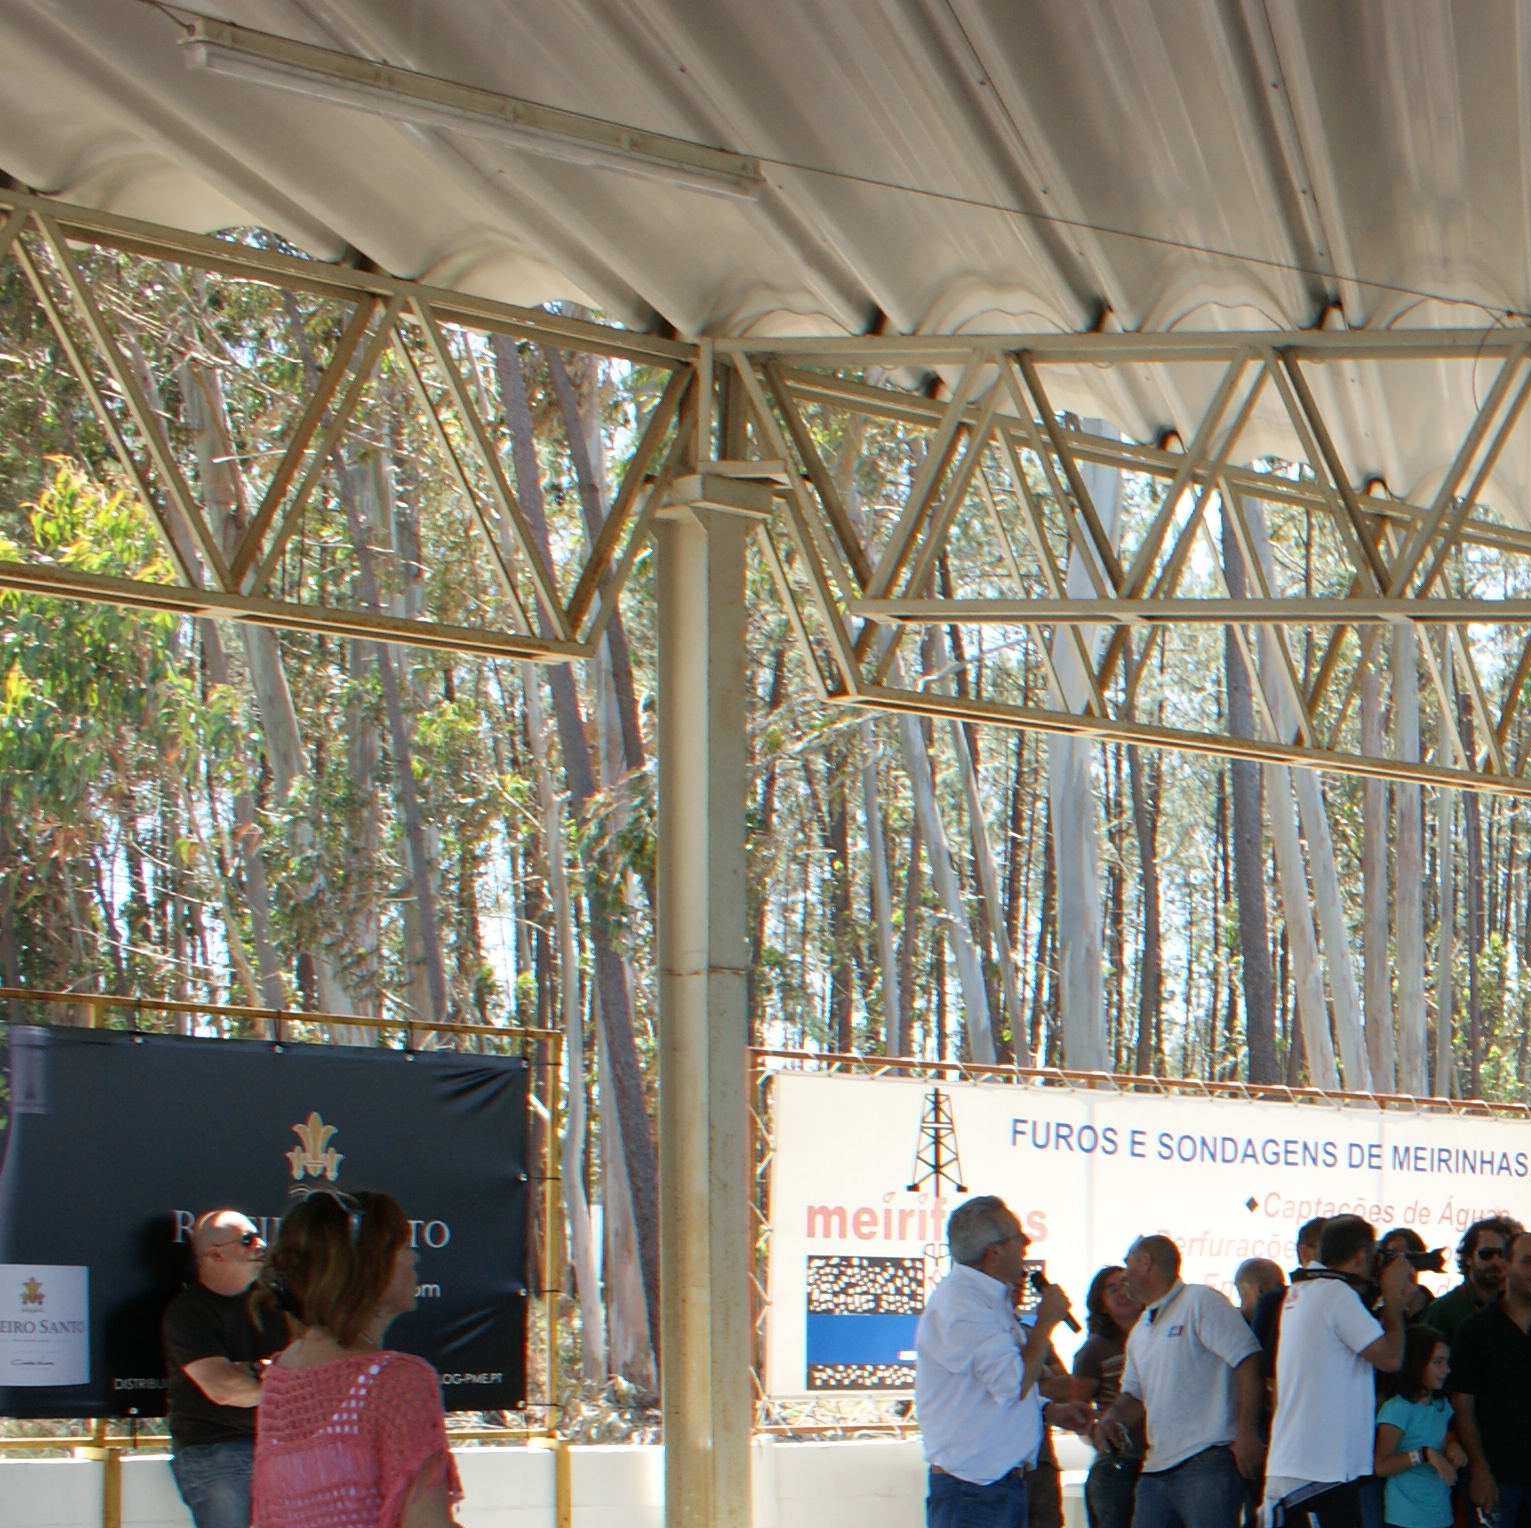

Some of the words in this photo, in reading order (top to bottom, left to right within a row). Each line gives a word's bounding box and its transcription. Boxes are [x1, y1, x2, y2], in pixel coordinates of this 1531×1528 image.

[1010, 1118, 1118, 1155] FUROS
[1130, 1130, 1146, 1159] E
[1157, 1133, 1338, 1169] SONDAGENS
[1348, 1143, 1382, 1170] DE
[806, 1192, 1048, 1243] meirifs
[1404, 1200, 1430, 1225] de
